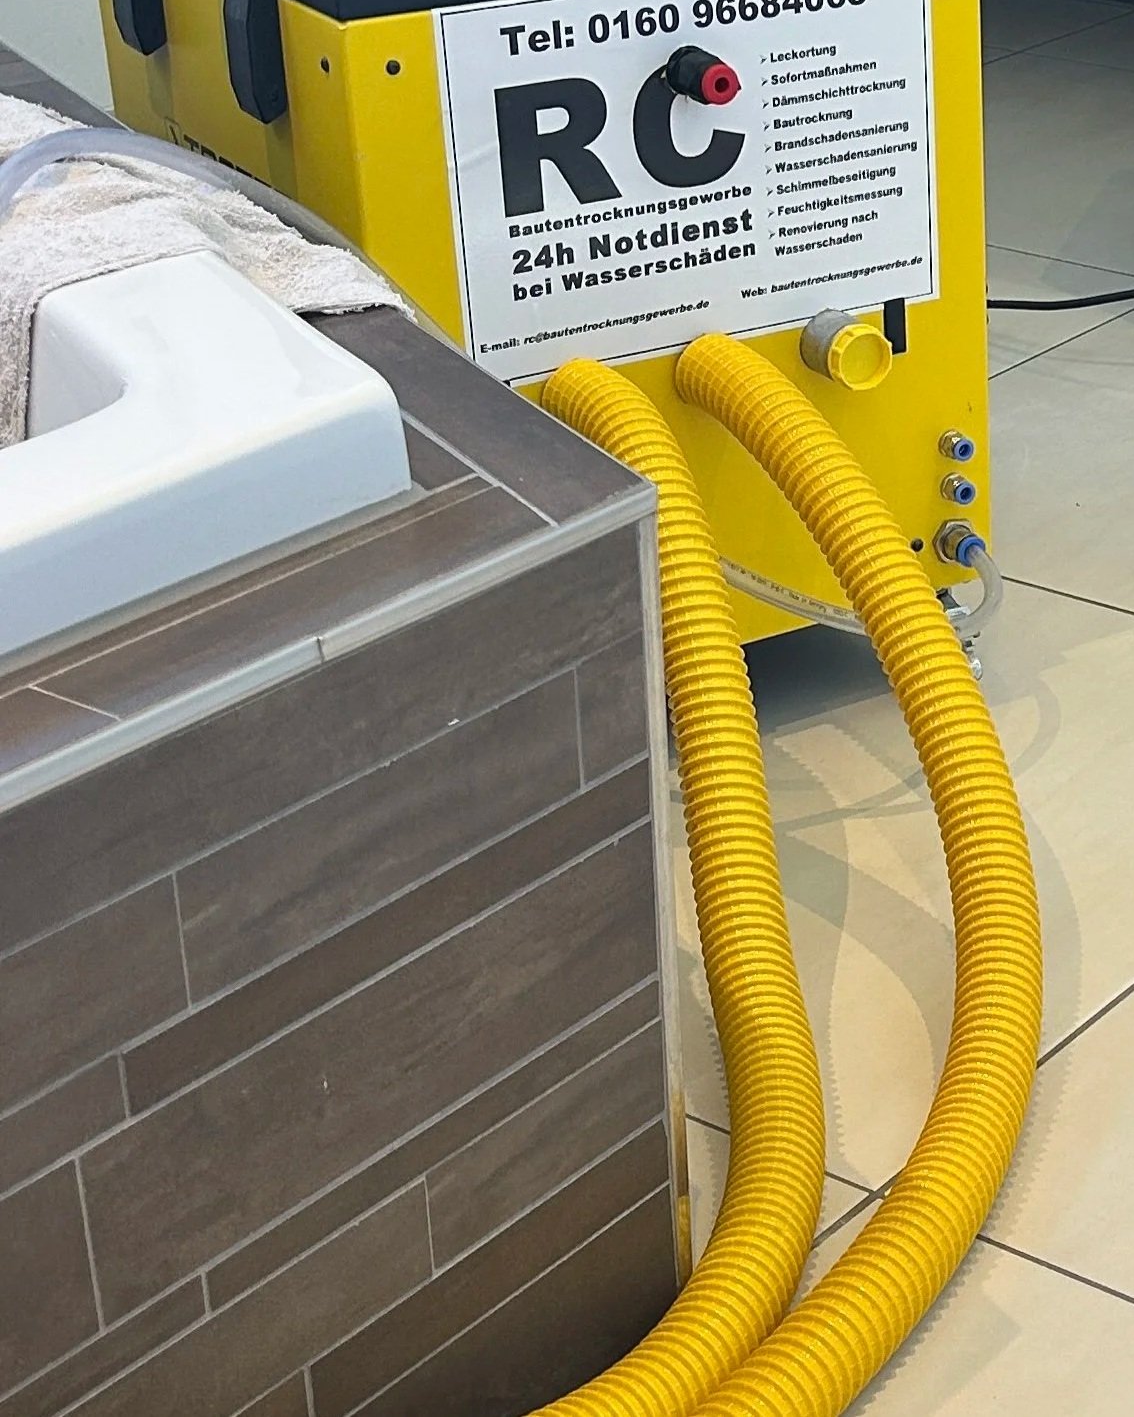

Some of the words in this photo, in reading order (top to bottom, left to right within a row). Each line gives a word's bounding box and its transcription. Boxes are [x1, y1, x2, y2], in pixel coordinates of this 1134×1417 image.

[500, 20, 574, 56] Tel:
[588, 4, 680, 43] 0160
[770, 45, 836, 63] Leckortung
[771, 61, 877, 85] Sofortmaßnahmen
[772, 78, 906, 108] Dämmschichttrocknung
[773, 109, 853, 130] Bautrocknung
[494, 66, 746, 217] RC
[775, 121, 909, 151] Brandschadensanierung
[775, 141, 917, 173] Wasserschadensanierung
[776, 166, 896, 195] Schimmelbeseitigung
[508, 185, 752, 238] Bautentrocknungsgewerbe
[778, 186, 903, 216] Feuchtigkeitsmessung
[778, 217, 848, 237] Renovierung
[851, 210, 878, 224] nach
[512, 243, 575, 275] 24h
[589, 209, 753, 259] Notdienst
[775, 232, 863, 256] Wasserschaden
[513, 278, 552, 301] bei
[561, 242, 756, 291] Wasserschäden
[741, 288, 767, 298] Web:
[770, 256, 922, 293] bautentrocknungsgewerbe.de
[480, 338, 520, 353] E-mail:
[523, 300, 710, 345] rc@bautentrocknungsgewerbe.de
